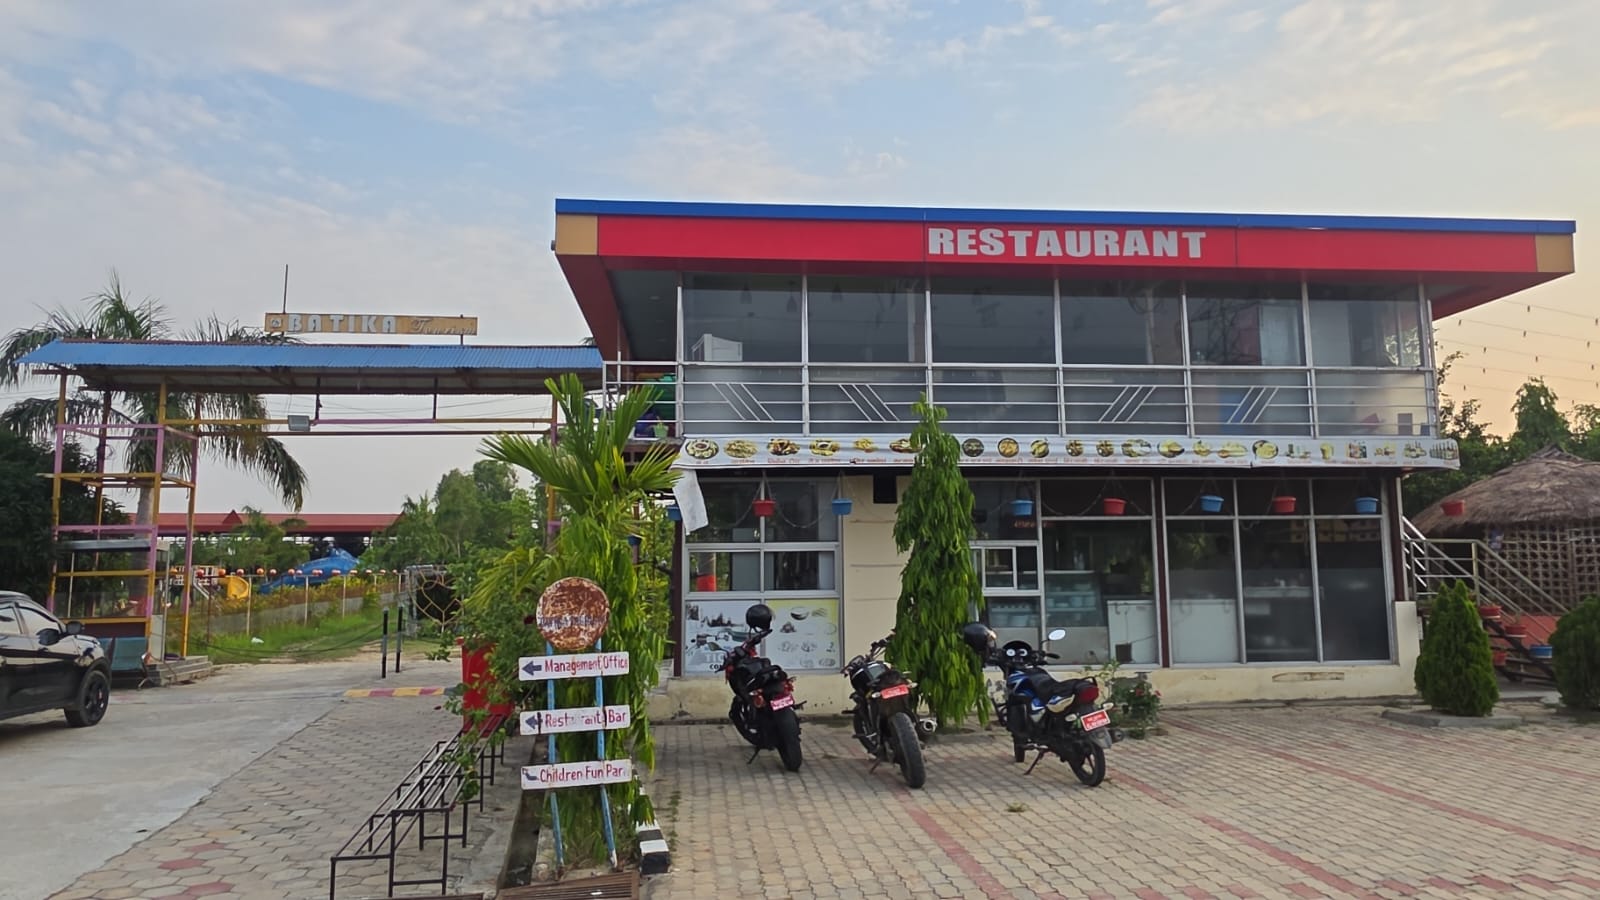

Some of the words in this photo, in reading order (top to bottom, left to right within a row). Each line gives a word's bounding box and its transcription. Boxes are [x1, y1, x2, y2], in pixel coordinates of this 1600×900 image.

[928, 227, 1207, 258] RESTAURANT
[287, 313, 397, 333] BATIKA
[545, 656, 601, 675] Management
[608, 709, 626, 723] Bar
[540, 767, 583, 783] Children
[585, 765, 604, 779] Fun
